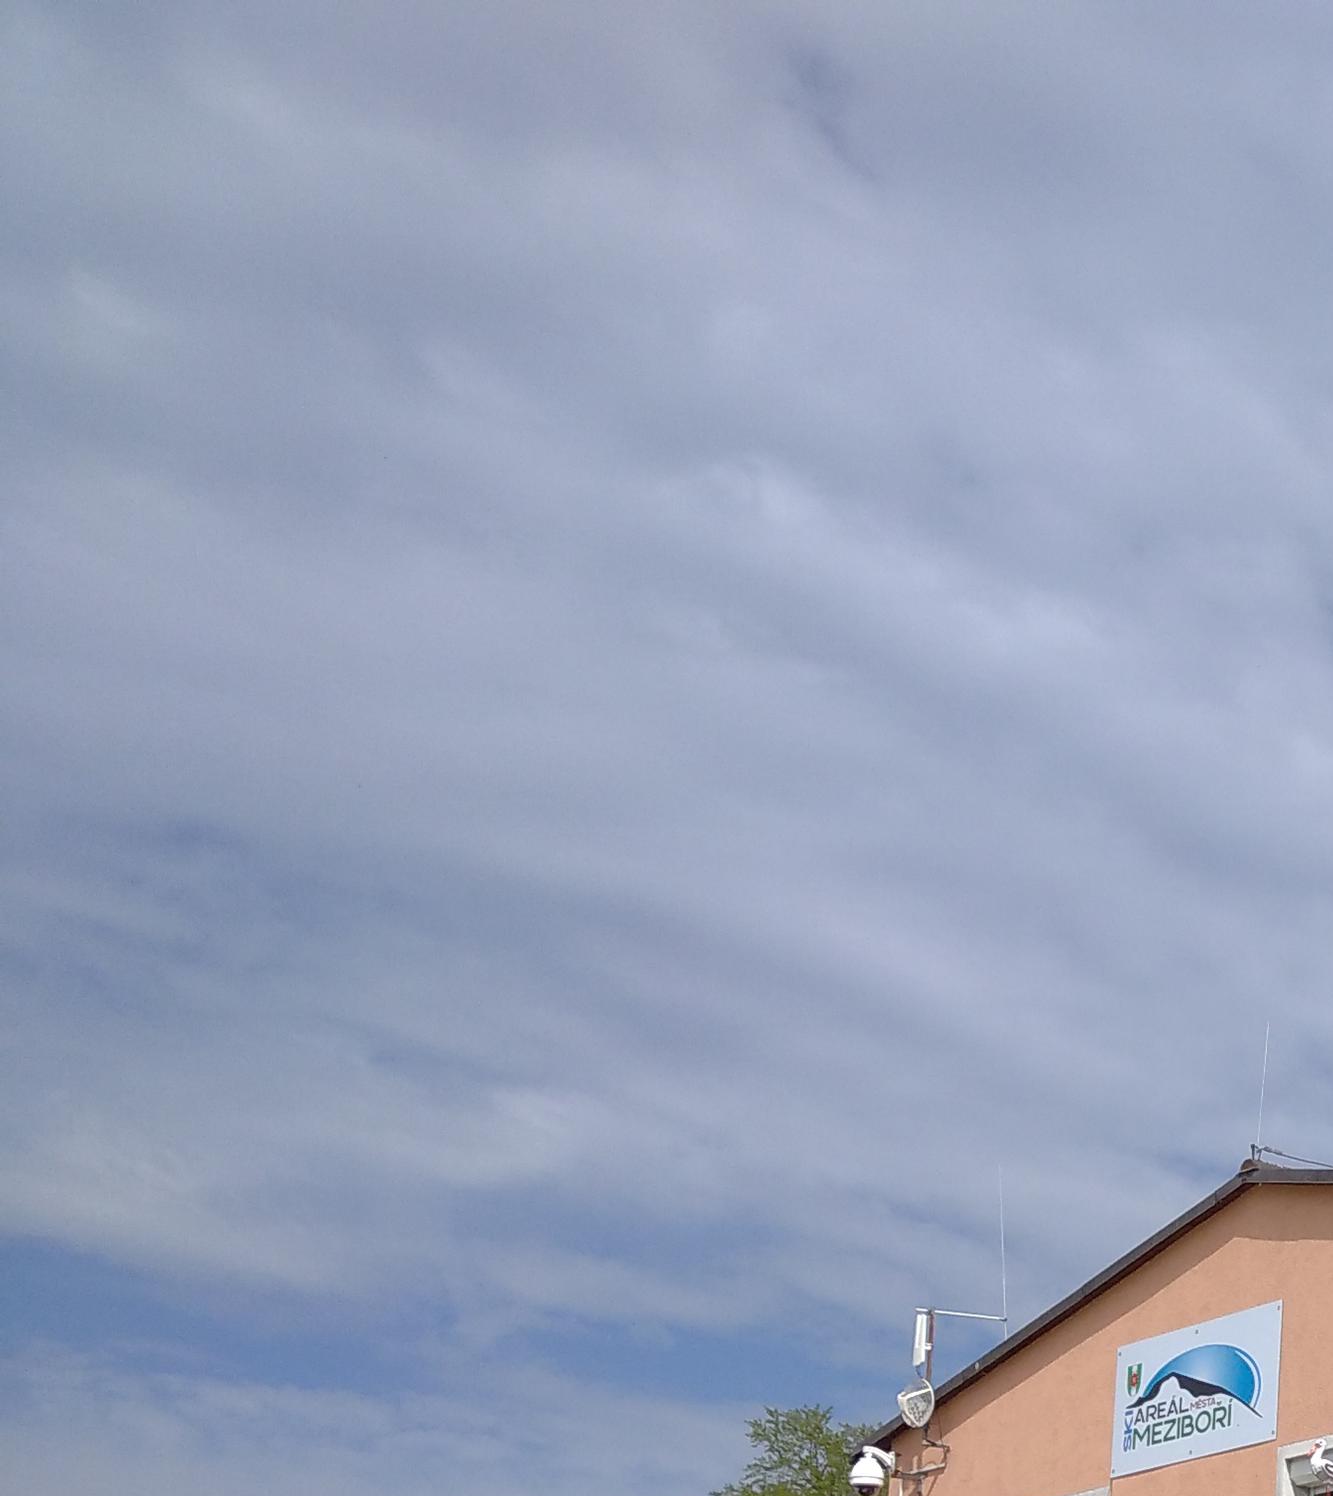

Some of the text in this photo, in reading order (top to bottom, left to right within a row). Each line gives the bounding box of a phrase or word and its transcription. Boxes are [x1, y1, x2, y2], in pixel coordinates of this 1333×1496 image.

[1123, 1410, 1134, 1452] SKI
[1132, 1398, 1233, 1450] MEZIBOŘÍ
[1133, 1395, 1216, 1425] AREÁL MĚSTA
